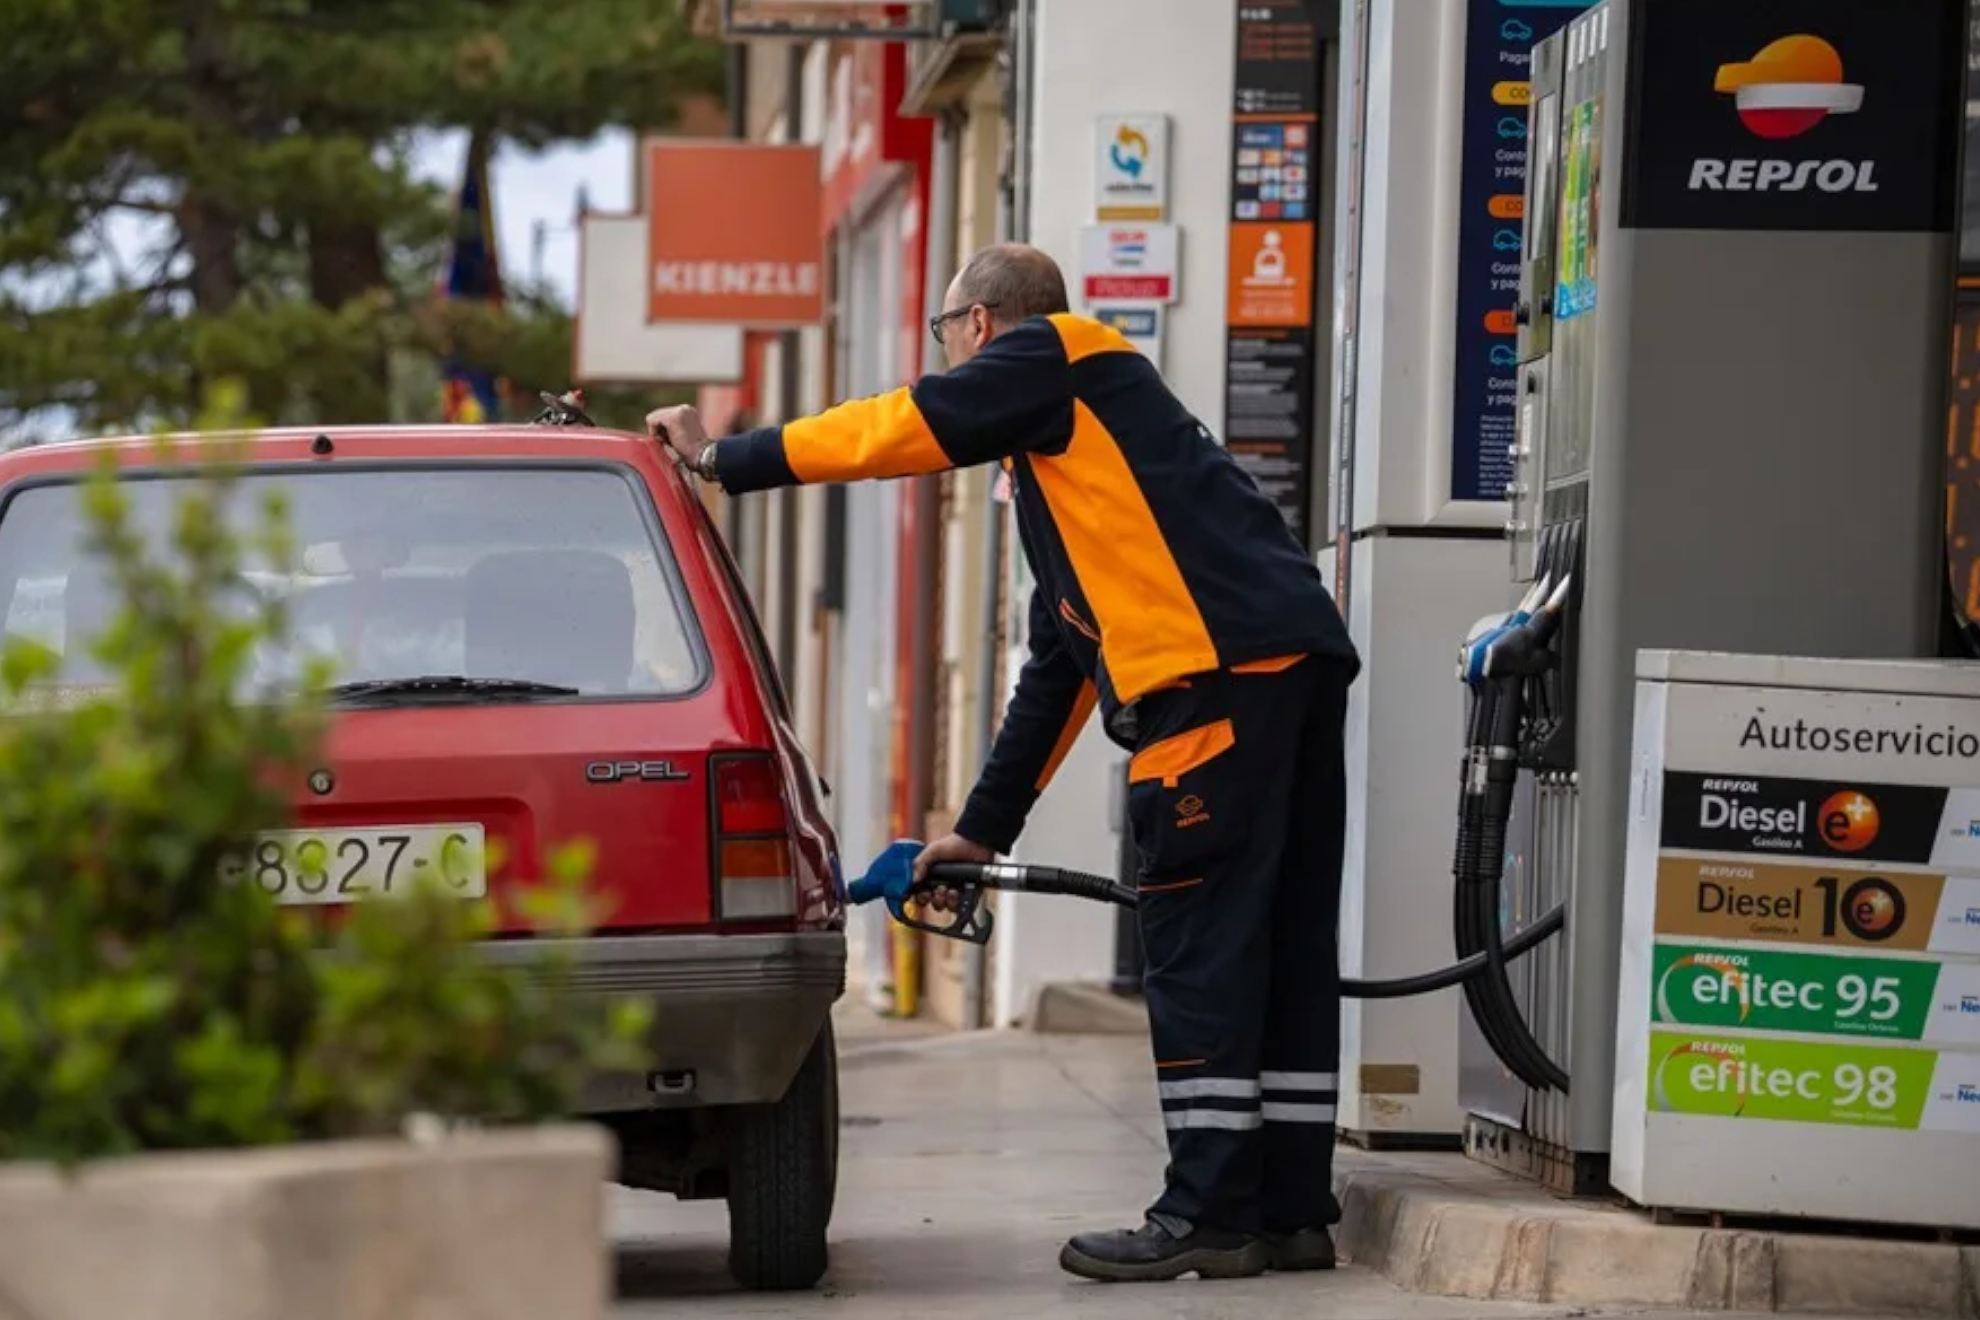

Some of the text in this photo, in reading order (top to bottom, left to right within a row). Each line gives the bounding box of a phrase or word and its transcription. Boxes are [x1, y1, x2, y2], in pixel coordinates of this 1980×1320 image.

[1687, 158, 1879, 193] REPSOL
[655, 261, 820, 295] KIENZLE
[1740, 716, 1980, 758] Autoservicio
[587, 760, 690, 780] OPEL
[1702, 778, 1759, 793] REPSOL
[1699, 794, 1807, 834] Diesel
[1699, 866, 1754, 879] REPSOL
[1698, 881, 1802, 920] Diesel
[1693, 952, 1749, 966] REPSOL
[1691, 971, 1901, 1020] efitec 95
[1689, 1041, 1746, 1055] REPSOL
[1689, 1060, 1897, 1110] efitec 98
